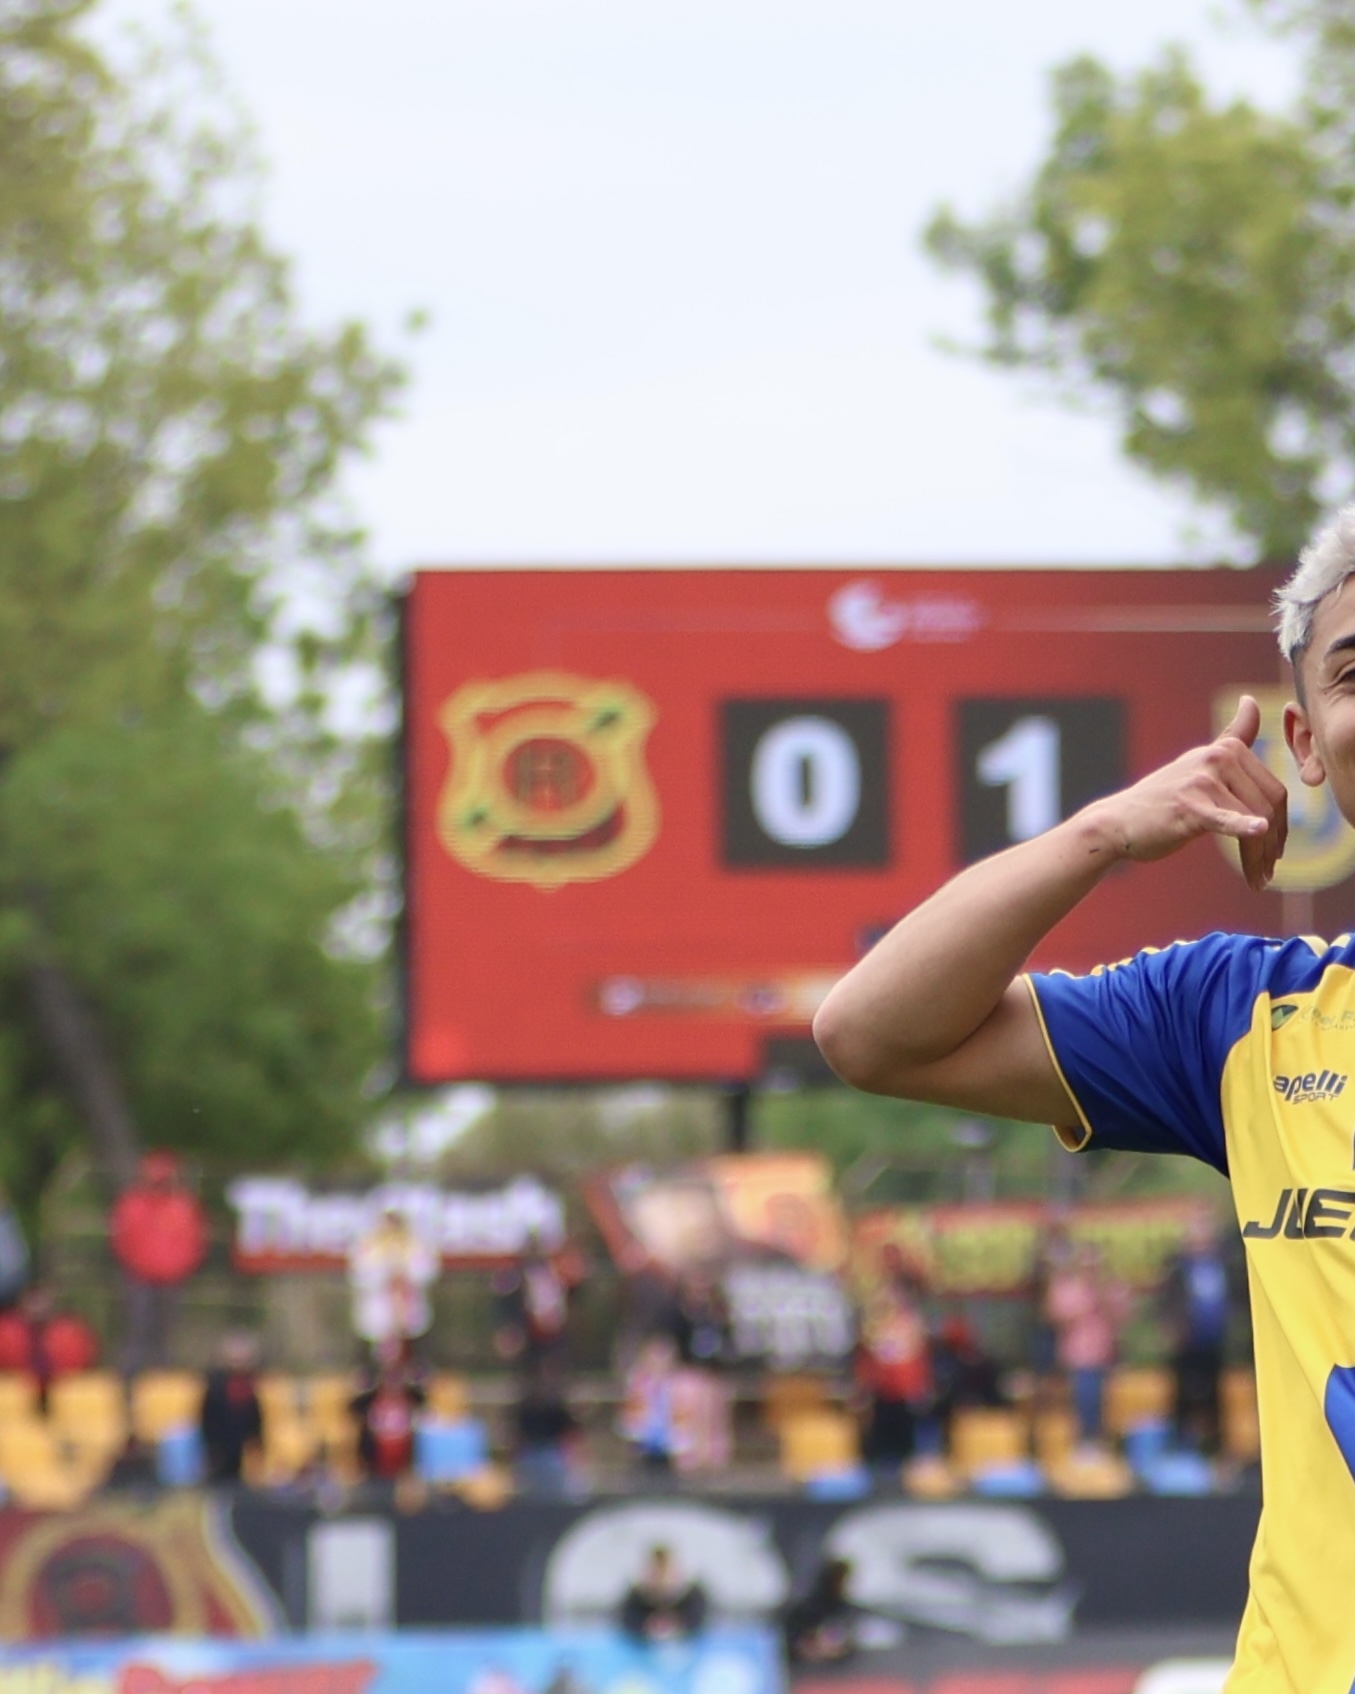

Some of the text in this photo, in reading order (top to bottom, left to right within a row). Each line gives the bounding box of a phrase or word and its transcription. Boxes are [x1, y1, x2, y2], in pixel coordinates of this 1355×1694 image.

[749, 713, 1063, 849] 0 1
[1273, 1069, 1348, 1101] apelli
[1292, 1091, 1341, 1105] SPORT
